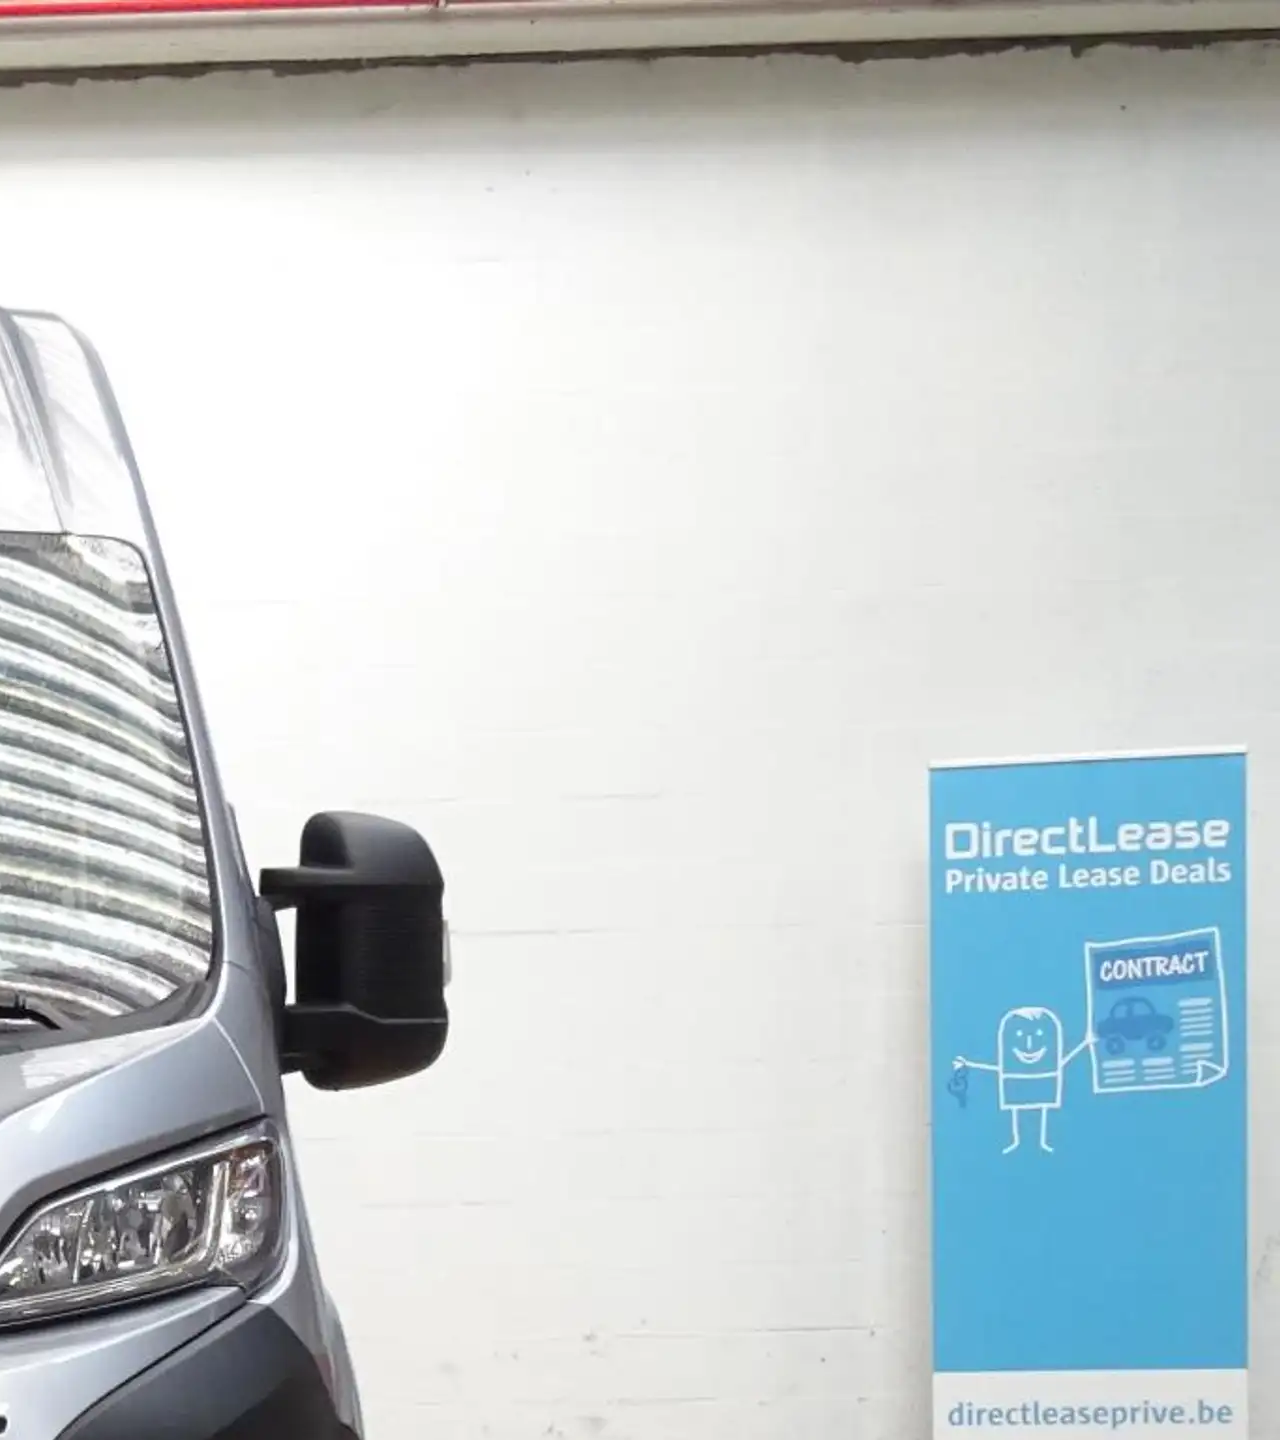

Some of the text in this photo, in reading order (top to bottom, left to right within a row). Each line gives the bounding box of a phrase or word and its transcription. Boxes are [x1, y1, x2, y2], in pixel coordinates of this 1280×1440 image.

[944, 816, 1231, 860] DirectLease
[945, 857, 1232, 894] Private Lease Deals
[1099, 950, 1210, 982] CONTRACT
[947, 1399, 1234, 1430] directleaseprive.be
